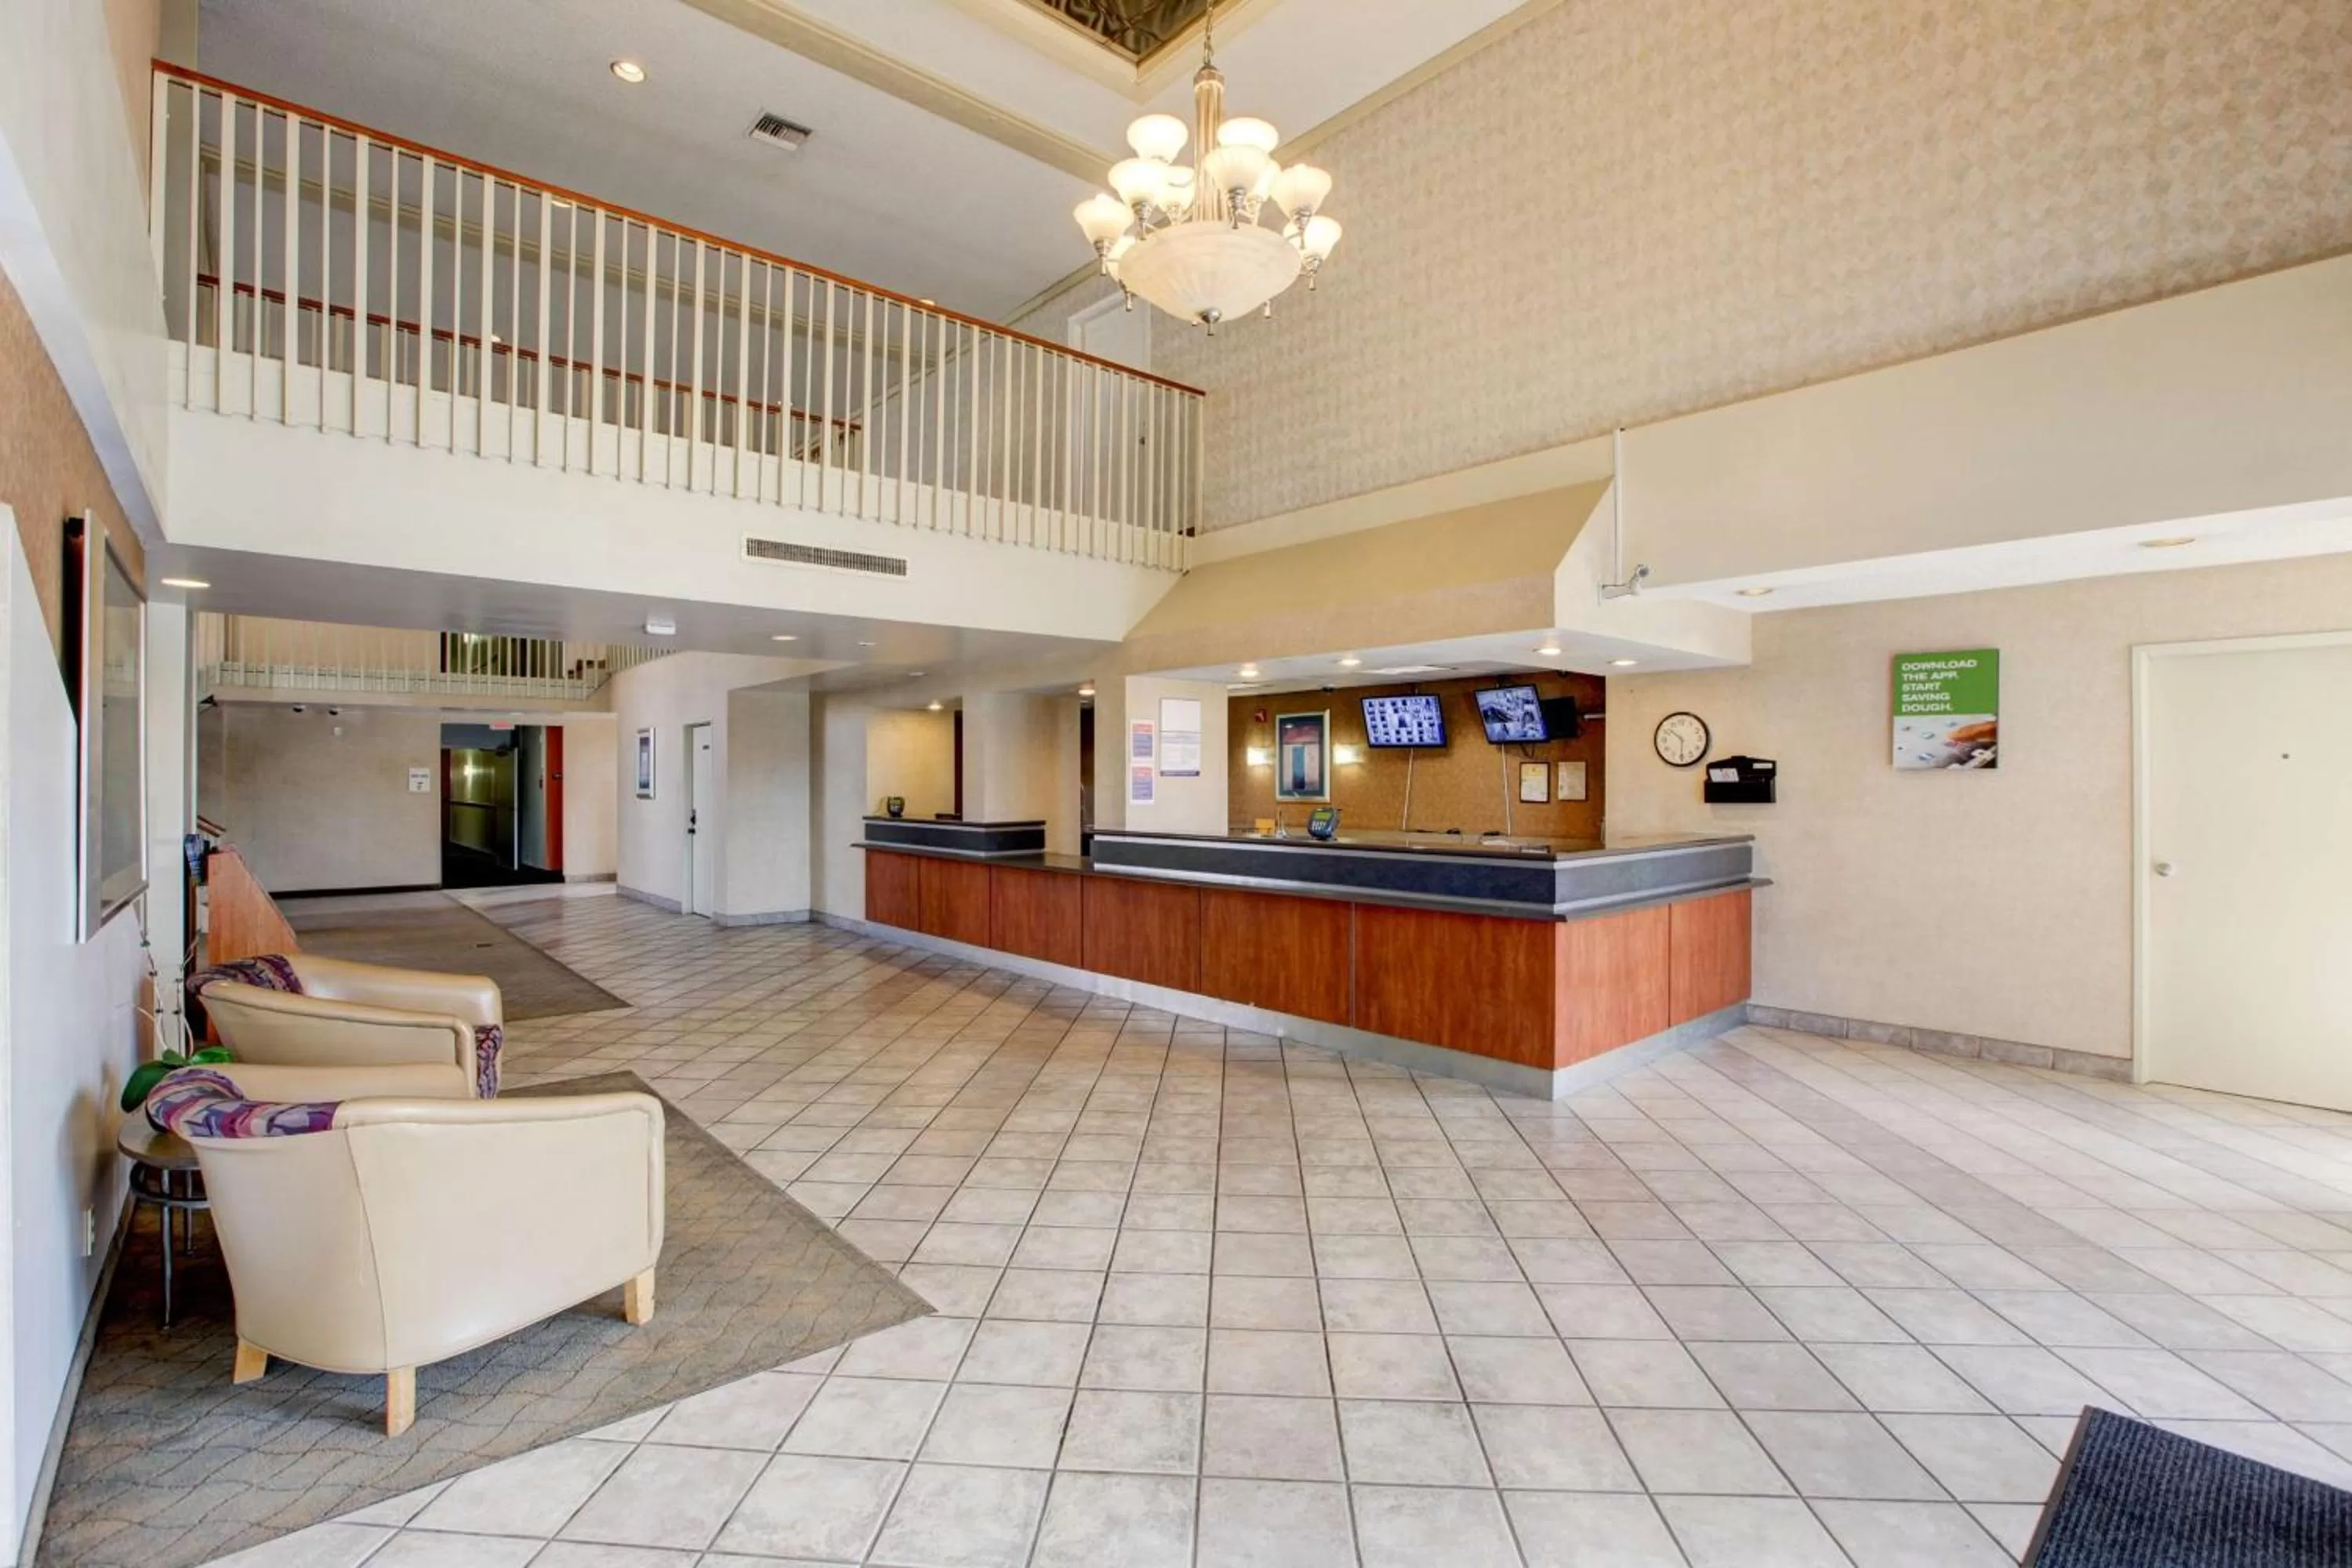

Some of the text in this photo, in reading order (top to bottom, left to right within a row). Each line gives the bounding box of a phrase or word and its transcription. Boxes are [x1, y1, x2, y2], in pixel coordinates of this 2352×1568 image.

[1902, 659, 1977, 671] DOWNLOAD
[1902, 671, 1959, 681] THE APP.
[1902, 682, 1941, 691] START
[1901, 692, 1951, 702] SAVING
[1901, 703, 1953, 713] DOUGH.
